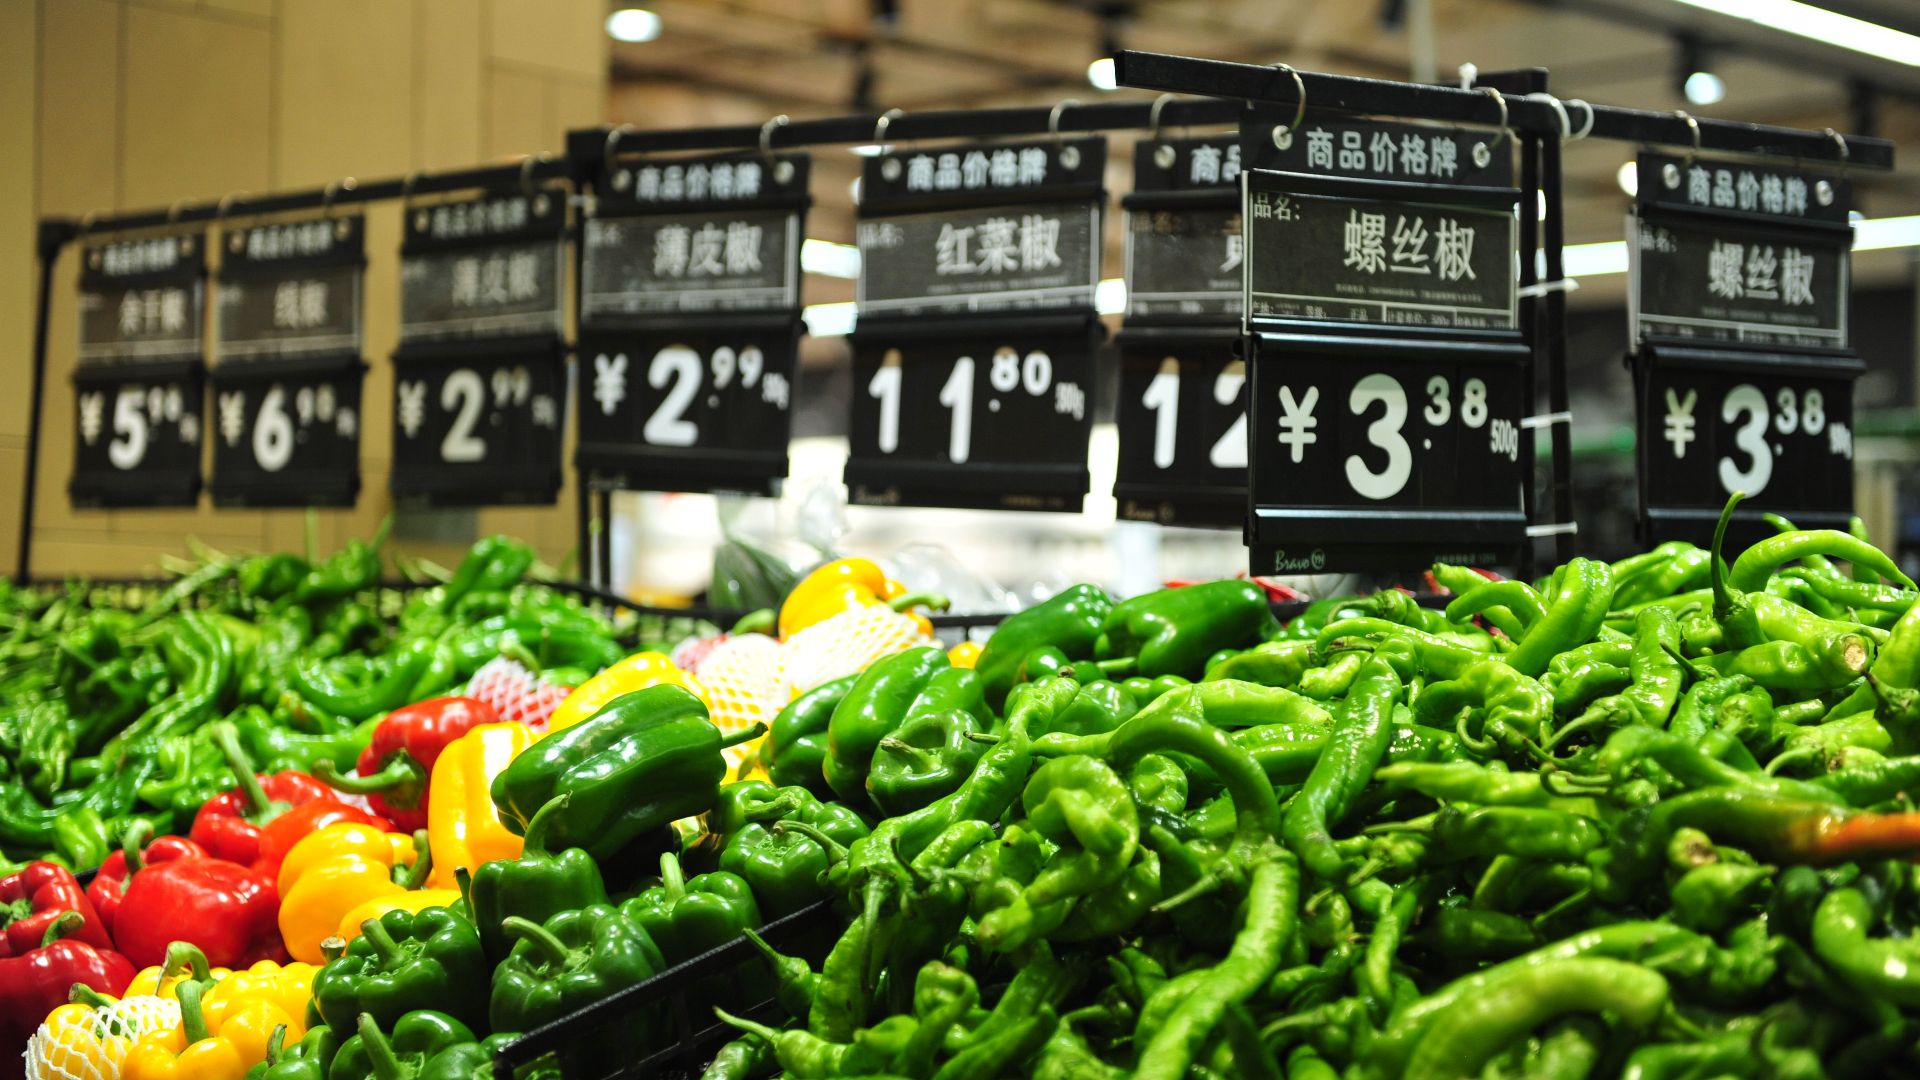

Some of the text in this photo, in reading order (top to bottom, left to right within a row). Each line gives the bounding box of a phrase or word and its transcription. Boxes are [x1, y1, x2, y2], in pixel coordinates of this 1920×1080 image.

[906, 147, 1047, 193] 商品价格牌
[1306, 126, 1458, 177] 商品价格牌
[635, 162, 762, 201] 商品价格牌
[1688, 166, 1808, 216] 商品价格牌
[1252, 192, 1301, 222] 品名:
[653, 221, 763, 277] 薄皮椒
[935, 214, 1062, 276] 红菜椒
[1344, 208, 1477, 281] 螺丝椒
[1708, 240, 1815, 306] 螺丝椒
[1490, 418, 1518, 463] 500g
[1274, 551, 1309, 573] Bravo
